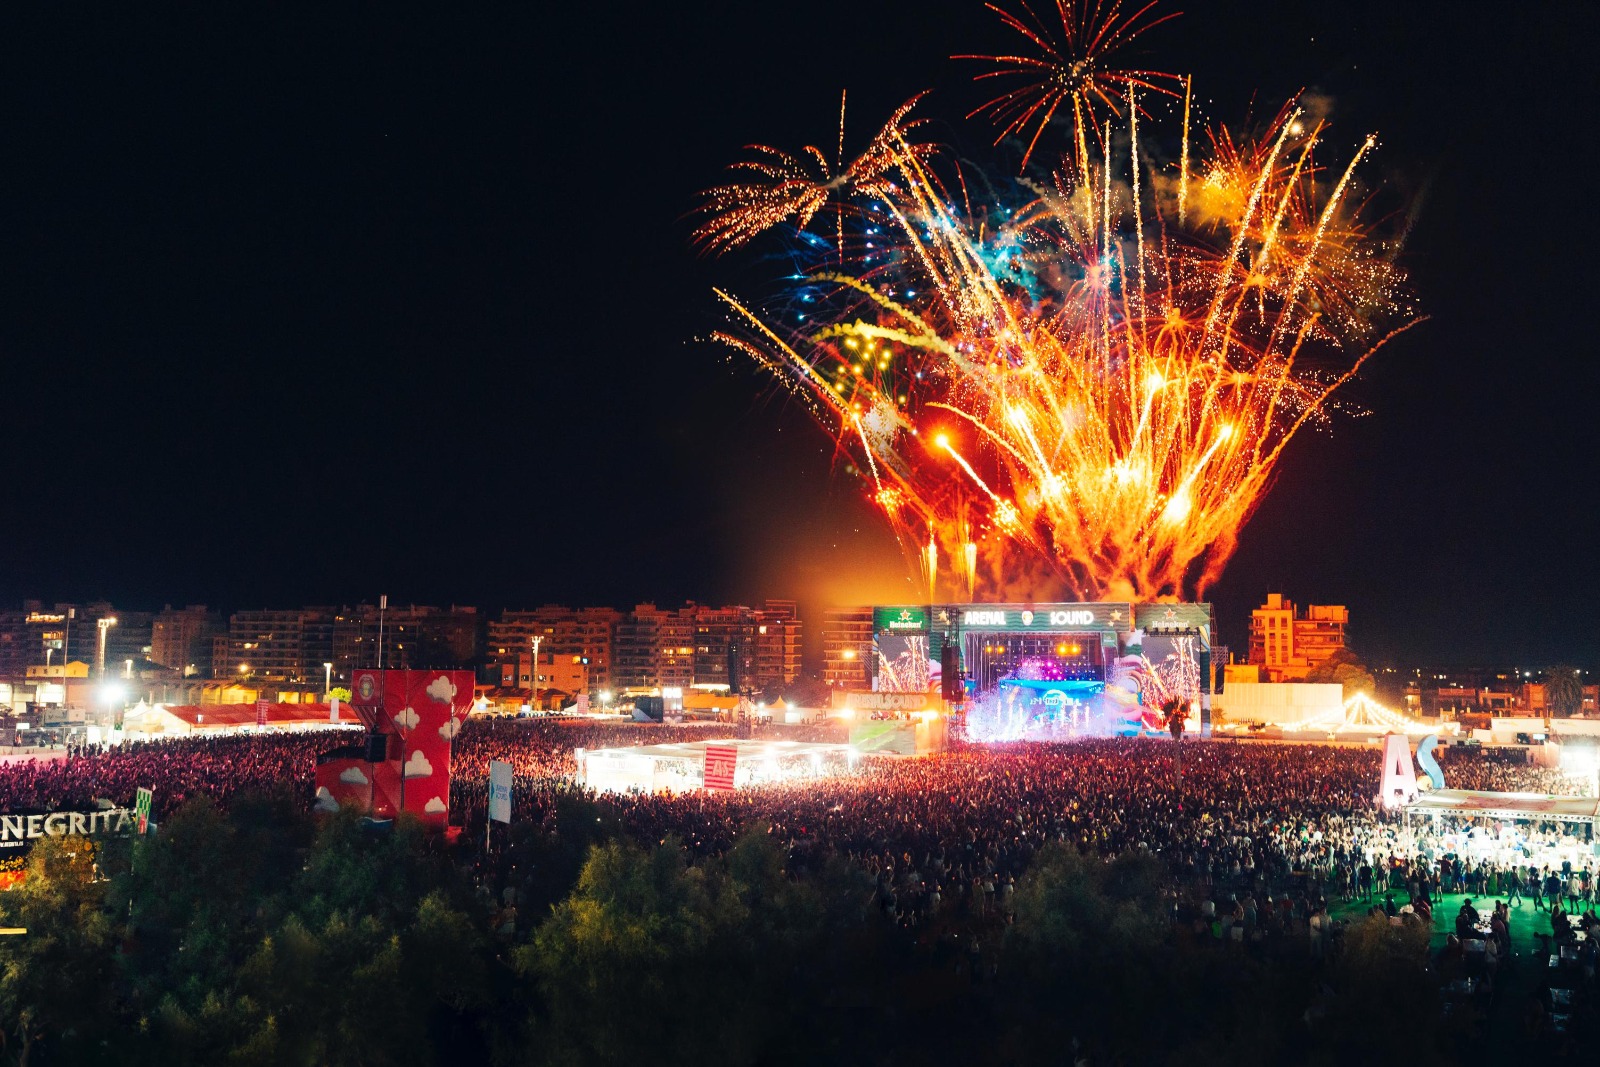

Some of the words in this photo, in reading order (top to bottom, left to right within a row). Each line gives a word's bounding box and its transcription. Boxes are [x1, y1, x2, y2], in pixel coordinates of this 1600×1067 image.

[889, 620, 922, 629] Heineken
[964, 610, 1007, 626] ARENAL
[1050, 610, 1095, 626] SOUND
[1152, 620, 1190, 628] Heineken
[711, 760, 729, 777] AS
[0, 808, 133, 841] NEGRITA
